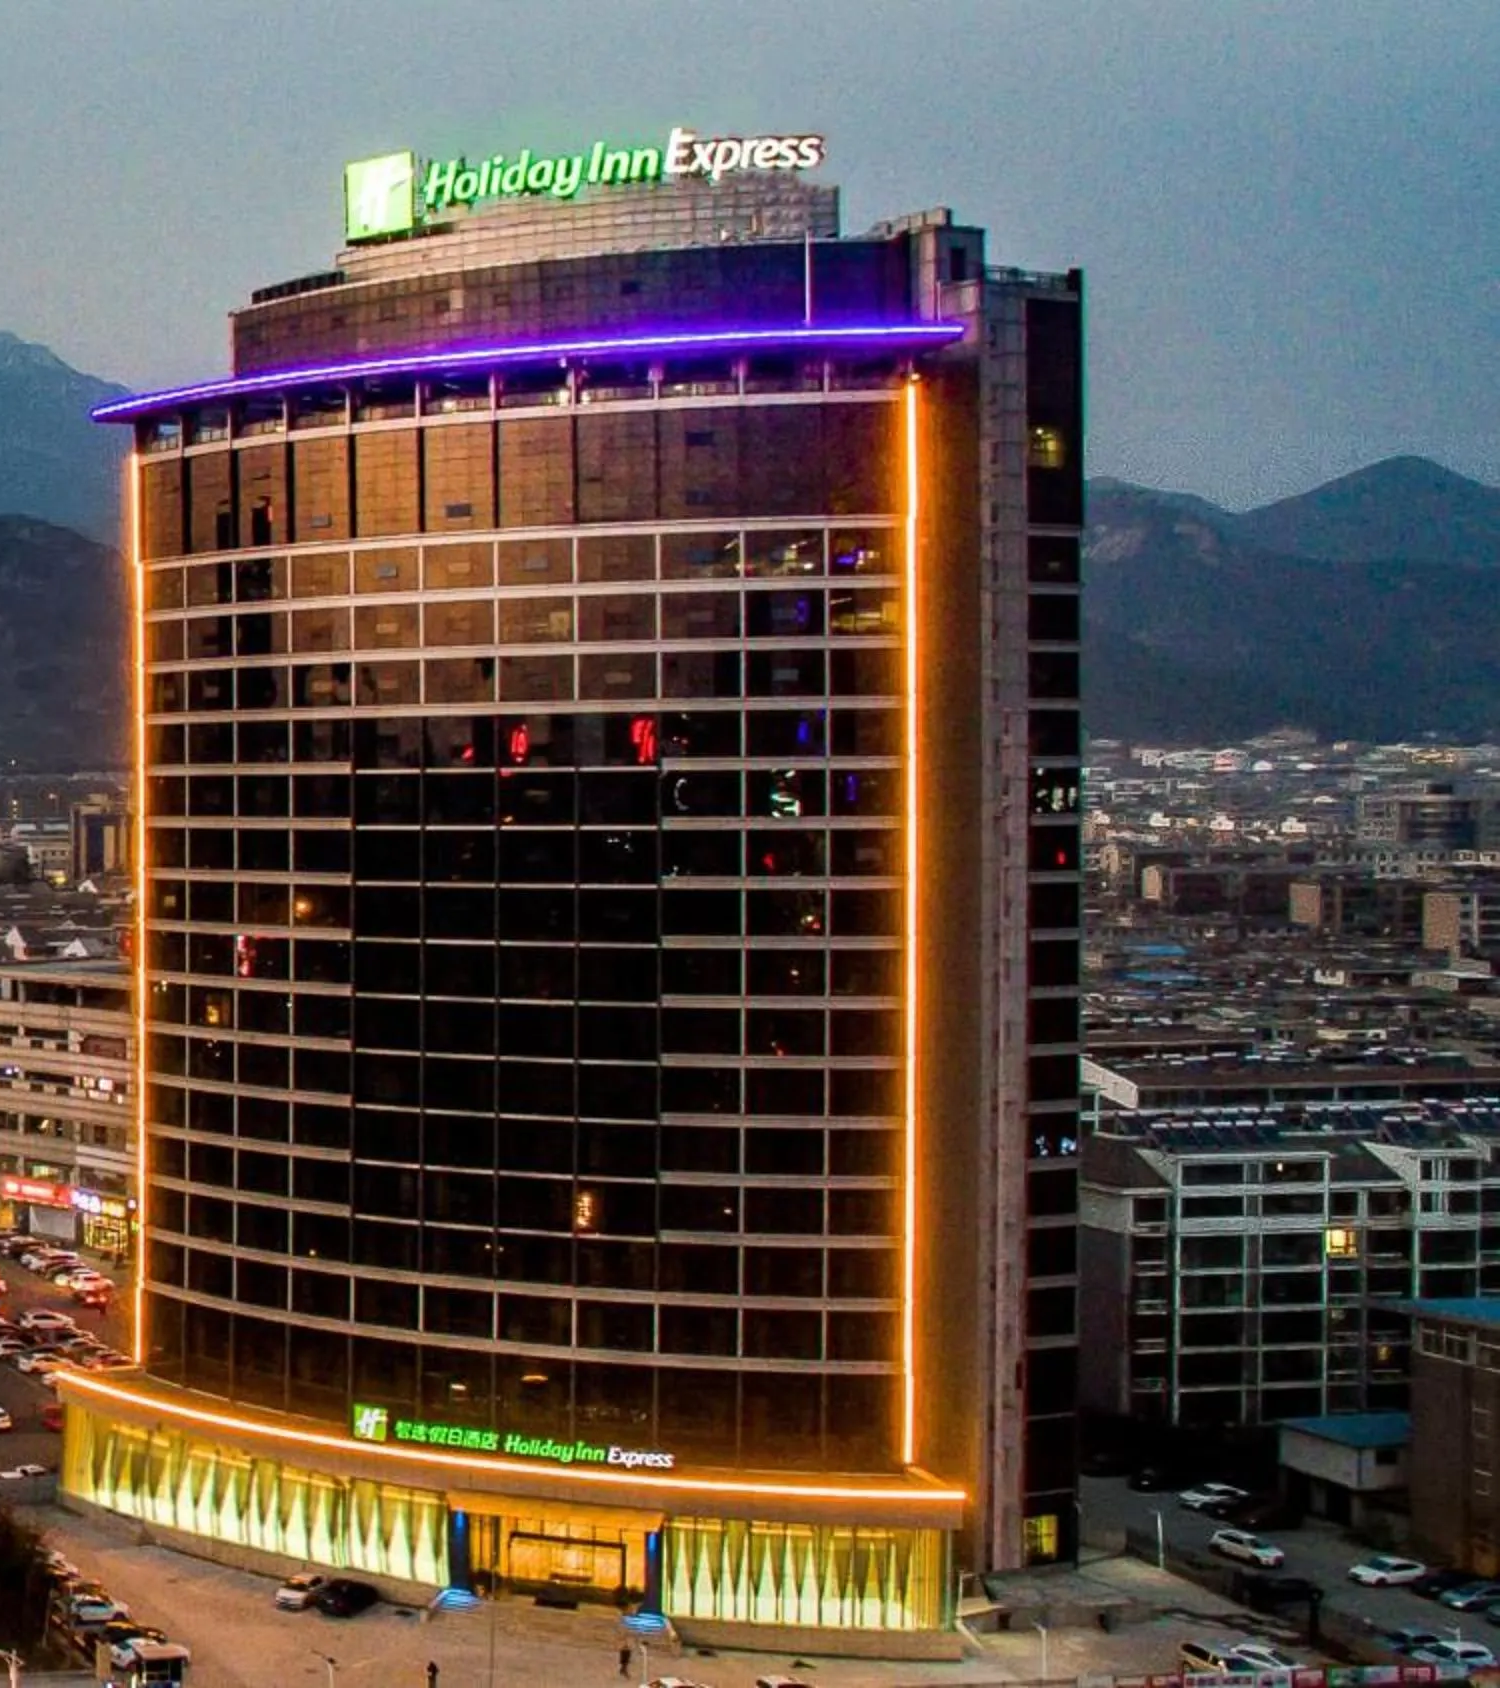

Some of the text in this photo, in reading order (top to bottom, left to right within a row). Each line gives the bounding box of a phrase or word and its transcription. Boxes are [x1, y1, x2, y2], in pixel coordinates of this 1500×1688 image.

[424, 127, 824, 204] Holiday Inn Express
[504, 1434, 675, 1468] Holiday Inn Express
